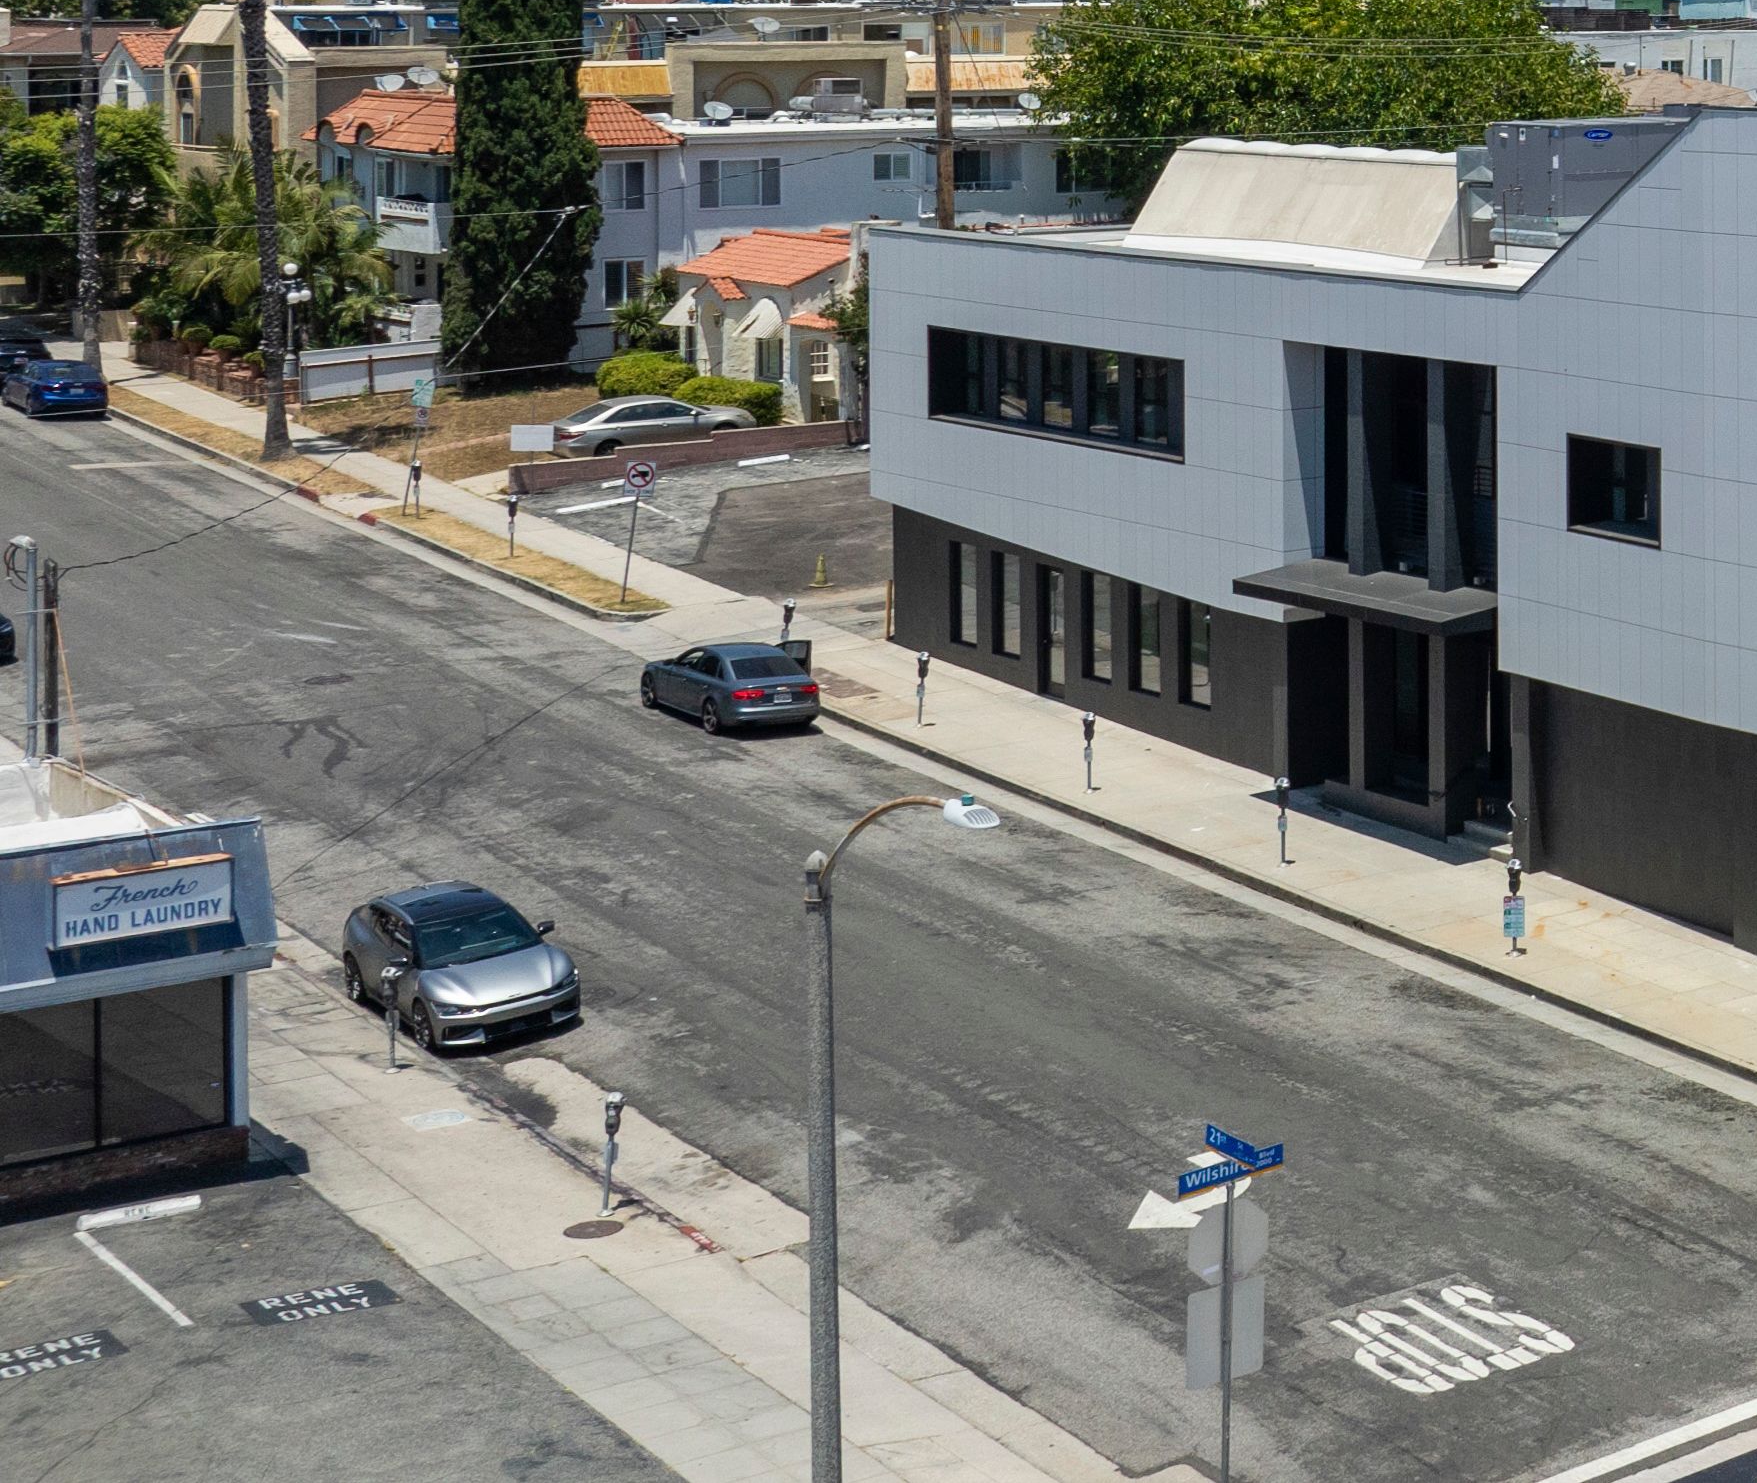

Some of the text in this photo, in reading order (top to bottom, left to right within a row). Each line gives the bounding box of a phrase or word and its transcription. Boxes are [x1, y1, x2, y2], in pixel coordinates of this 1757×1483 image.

[90, 877, 199, 912] French
[65, 897, 222, 938] HAND LAUNDRY
[1259, 1148, 1275, 1159] Blvd
[257, 1283, 365, 1310] RENE
[276, 1296, 371, 1322] ONLY
[1329, 1285, 1575, 1393] STOP
[0, 1346, 101, 1378] ONLY
